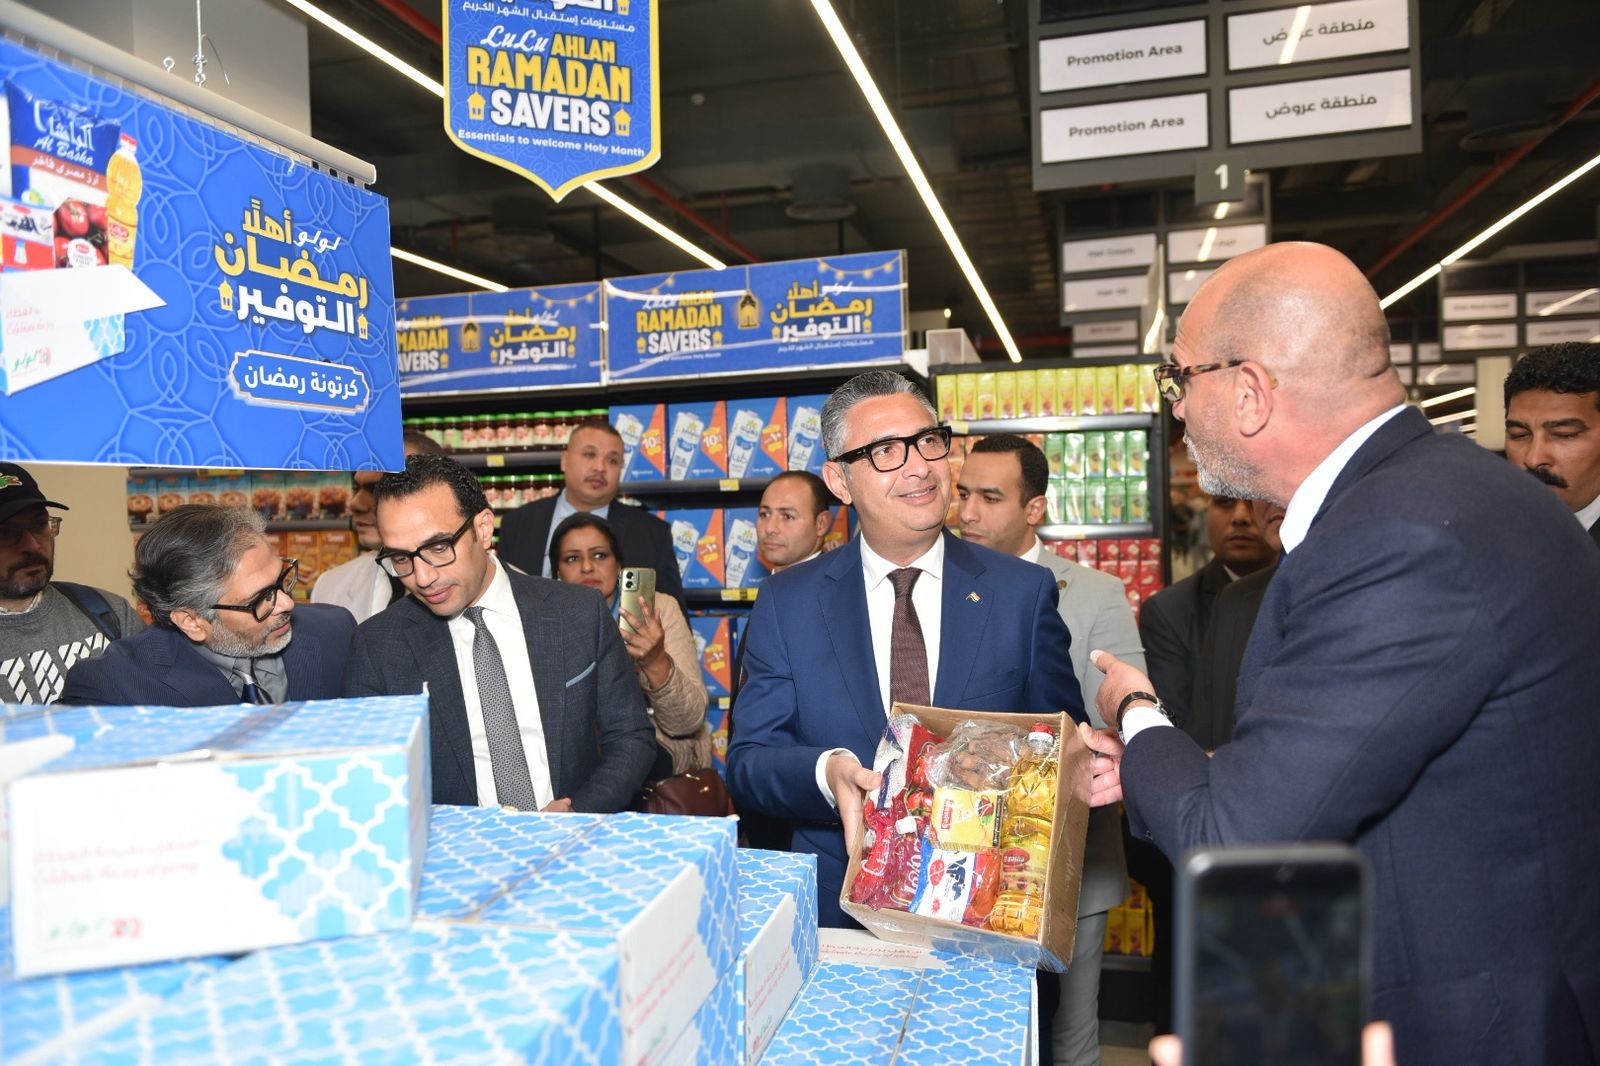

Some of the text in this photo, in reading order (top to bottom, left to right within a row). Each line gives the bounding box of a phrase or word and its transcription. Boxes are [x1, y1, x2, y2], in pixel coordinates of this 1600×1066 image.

[462, 2, 495, 12] الكريم
[497, 5, 529, 18] الشهر
[580, 15, 635, 32] مستلزمات
[1263, 19, 1375, 45] منطقة عرض
[480, 25, 616, 64] LuLu AHLAN
[1067, 45, 1183, 66] Promotion Area
[467, 46, 631, 103] RAMADAN
[490, 89, 611, 137] SAVERS
[1265, 94, 1377, 119] منطقة عروض
[1069, 117, 1184, 137] Promotion Area
[34, 136, 94, 167] Al Basha
[458, 129, 645, 158] Essentials to welcome Holy Month
[1214, 164, 1229, 190] 1
[293, 230, 341, 253] لولو
[215, 232, 368, 309] رمضان
[237, 283, 355, 334] التوفير
[637, 304, 722, 333] RAMADAN
[770, 296, 873, 323] رمضان
[397, 328, 449, 351] MADAN
[489, 324, 576, 348] رمضان
[648, 328, 711, 353] SAVERS
[782, 315, 861, 343] التوفير
[399, 351, 439, 372] AVERS
[499, 341, 566, 365] التوفير
[244, 365, 358, 399] كرتونة رمضان
